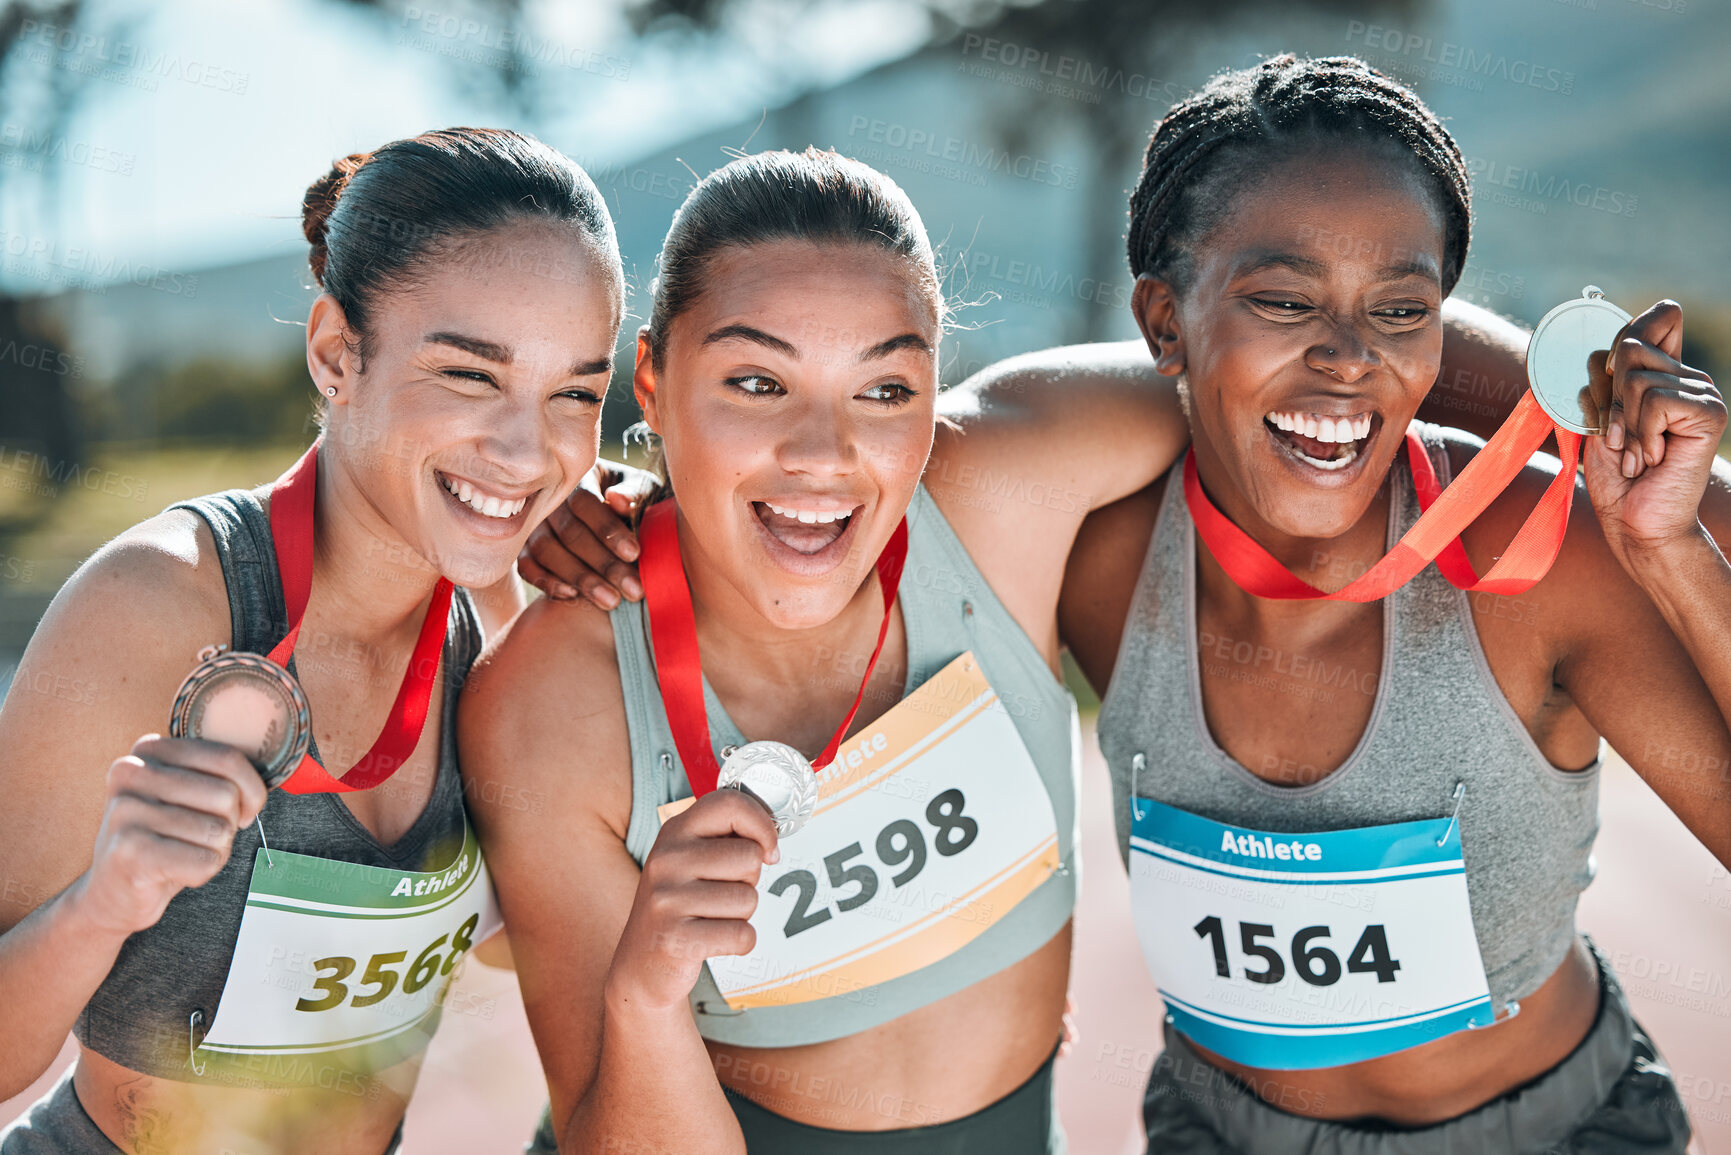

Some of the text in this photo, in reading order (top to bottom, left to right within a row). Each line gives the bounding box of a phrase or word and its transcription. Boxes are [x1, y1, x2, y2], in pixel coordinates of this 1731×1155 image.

[391, 854, 468, 897] Athlete
[768, 788, 979, 939] 2598
[1221, 830, 1322, 861] Athlete
[295, 912, 480, 1013] 3568
[1193, 915, 1401, 987] 1564
